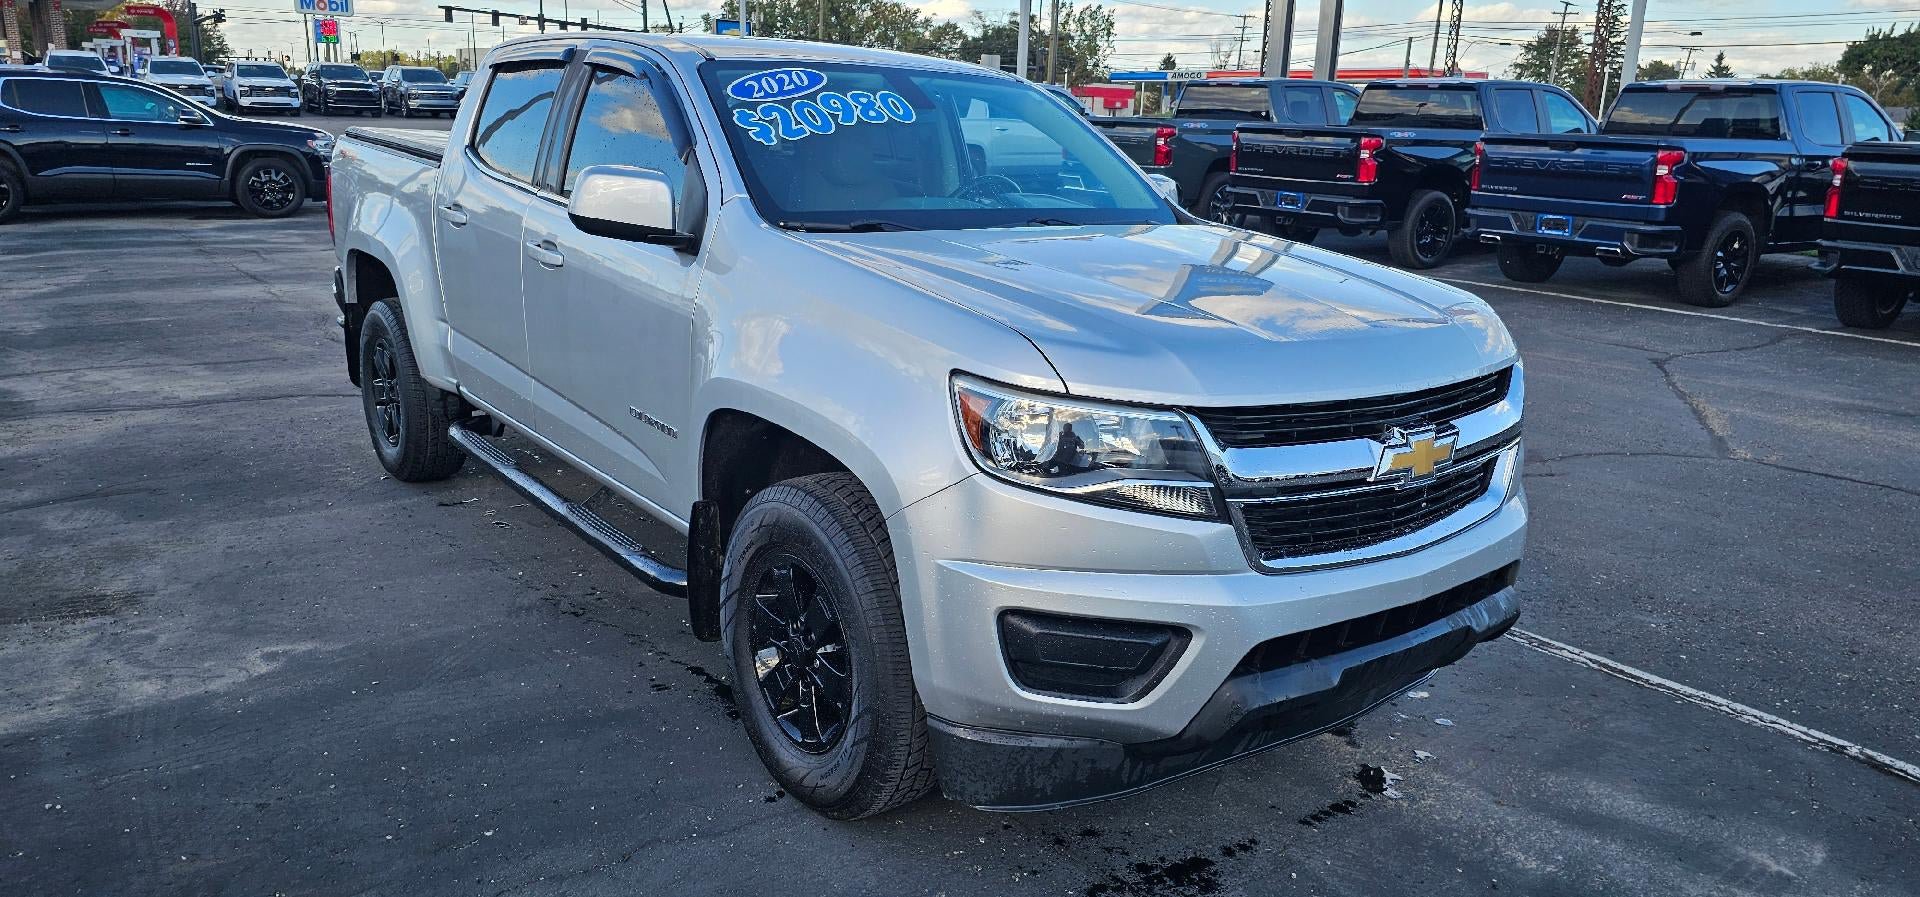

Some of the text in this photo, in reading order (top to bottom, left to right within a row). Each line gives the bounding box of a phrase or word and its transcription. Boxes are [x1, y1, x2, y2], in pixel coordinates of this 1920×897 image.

[301, 0, 349, 13] Mobil
[745, 70, 809, 98] 2020
[733, 90, 916, 145] $20980
[1843, 210, 1902, 220] SILVERADO
